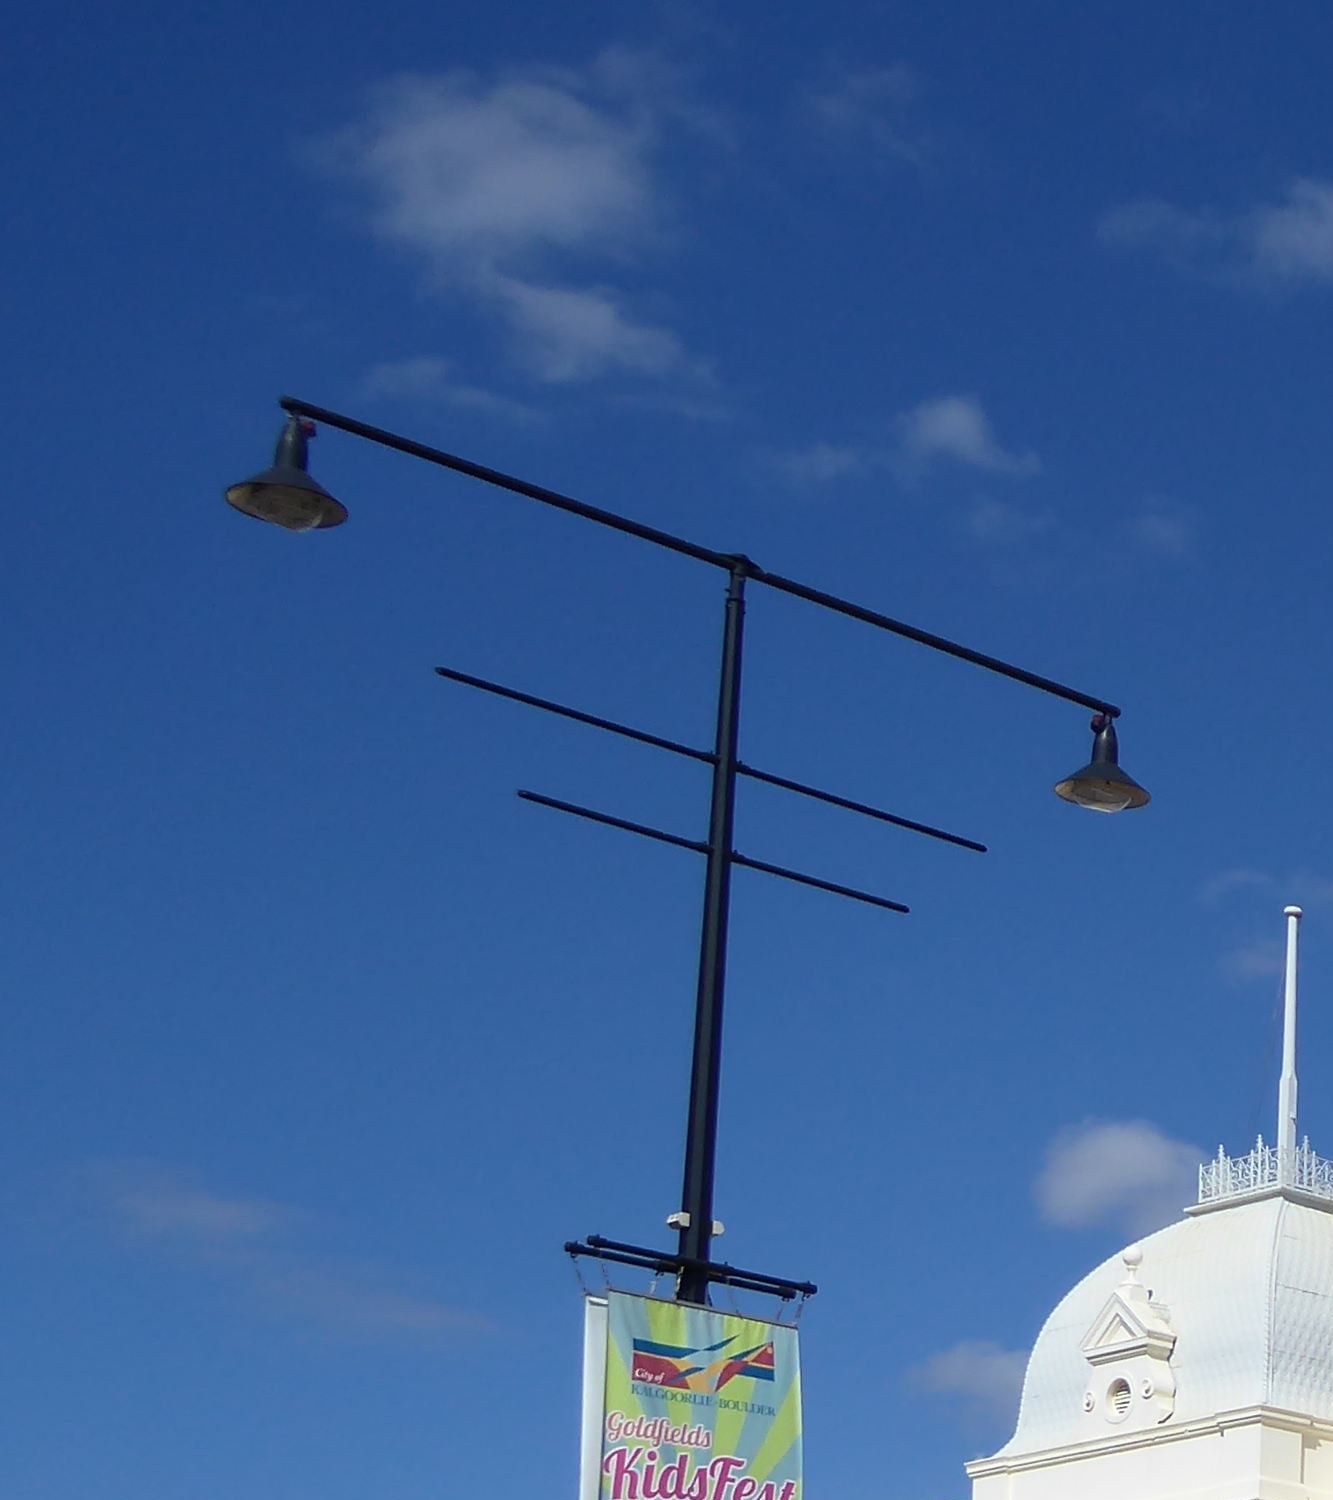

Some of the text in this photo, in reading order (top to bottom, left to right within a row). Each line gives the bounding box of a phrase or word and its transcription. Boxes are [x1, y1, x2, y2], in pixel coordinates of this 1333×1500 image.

[635, 1368, 666, 1384] City of
[607, 1411, 712, 1447] Goldfields
